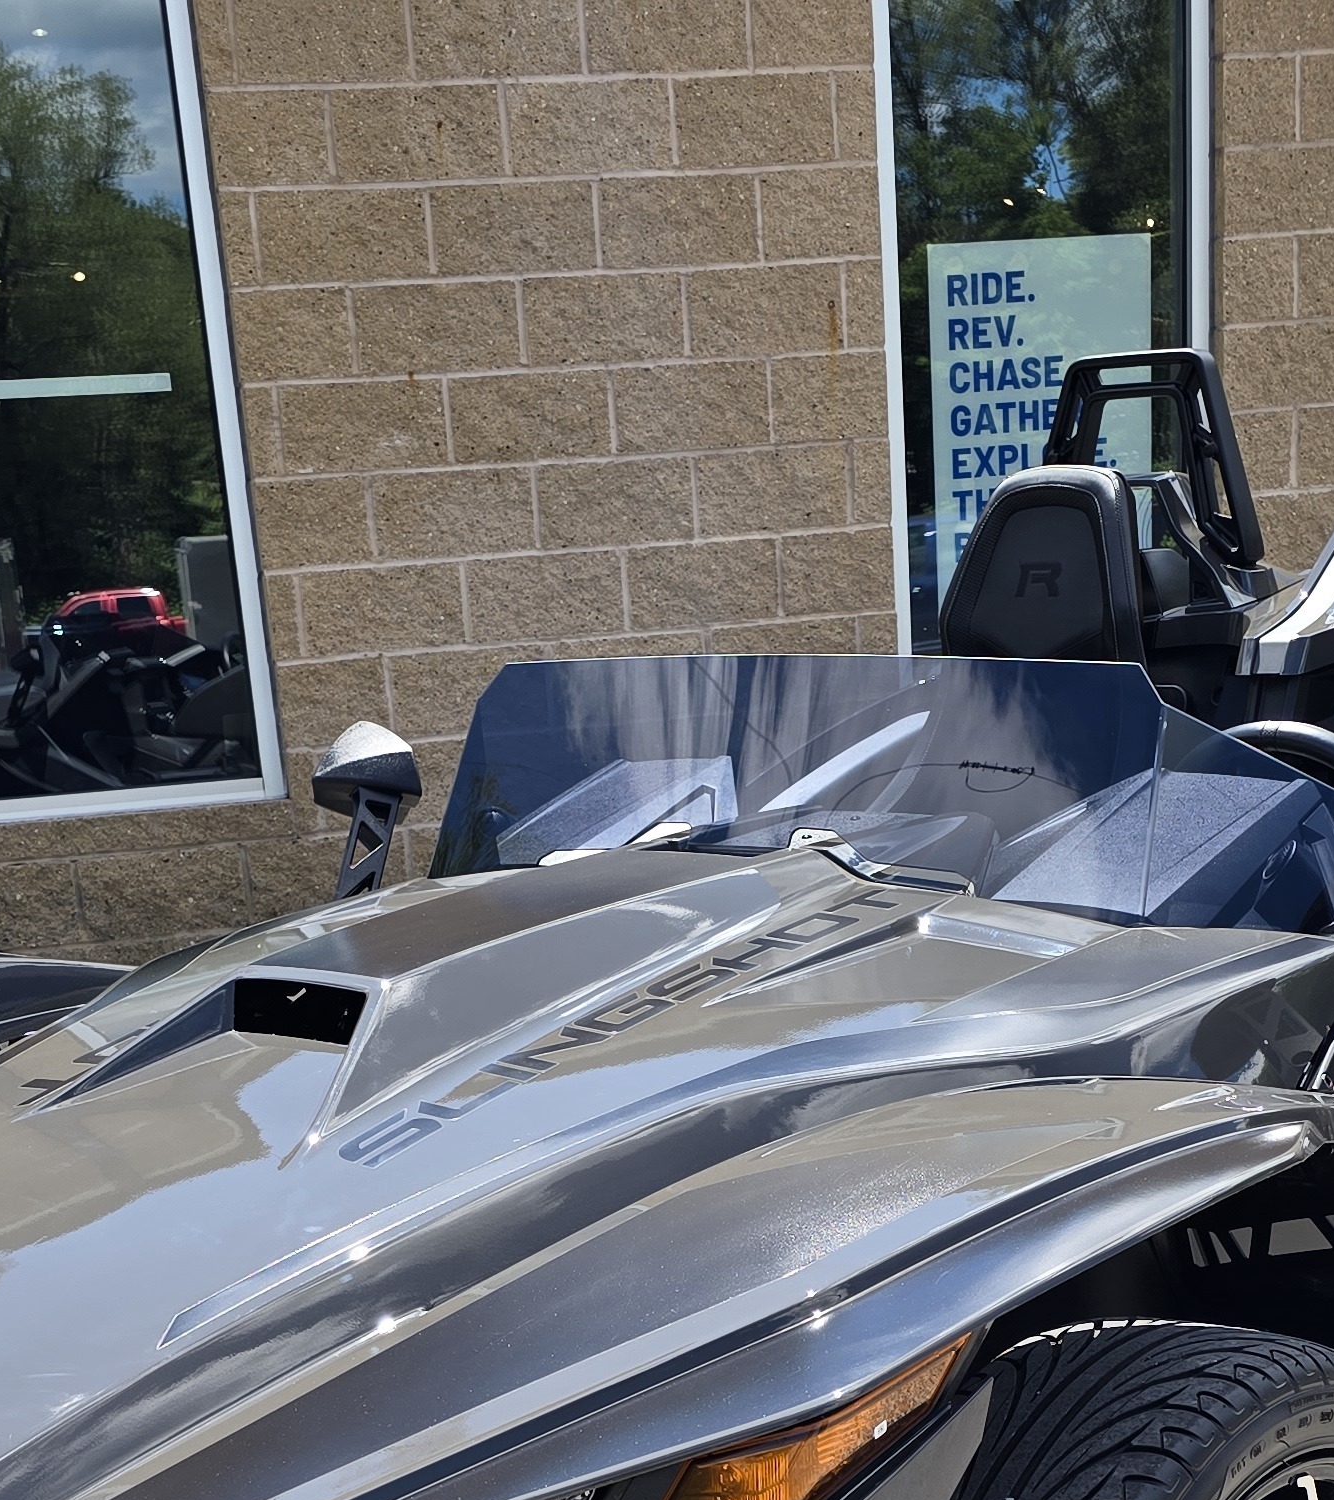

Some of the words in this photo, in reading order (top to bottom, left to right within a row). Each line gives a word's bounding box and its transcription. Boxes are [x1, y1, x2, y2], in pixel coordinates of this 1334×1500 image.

[947, 271, 1035, 307] RIDE.
[948, 315, 1024, 351] REV.
[949, 355, 1064, 394] CHASE
[950, 398, 1083, 438] GATHE
[952, 438, 1117, 480] EXPLE.
[337, 889, 905, 1170] SLINGSHOT
